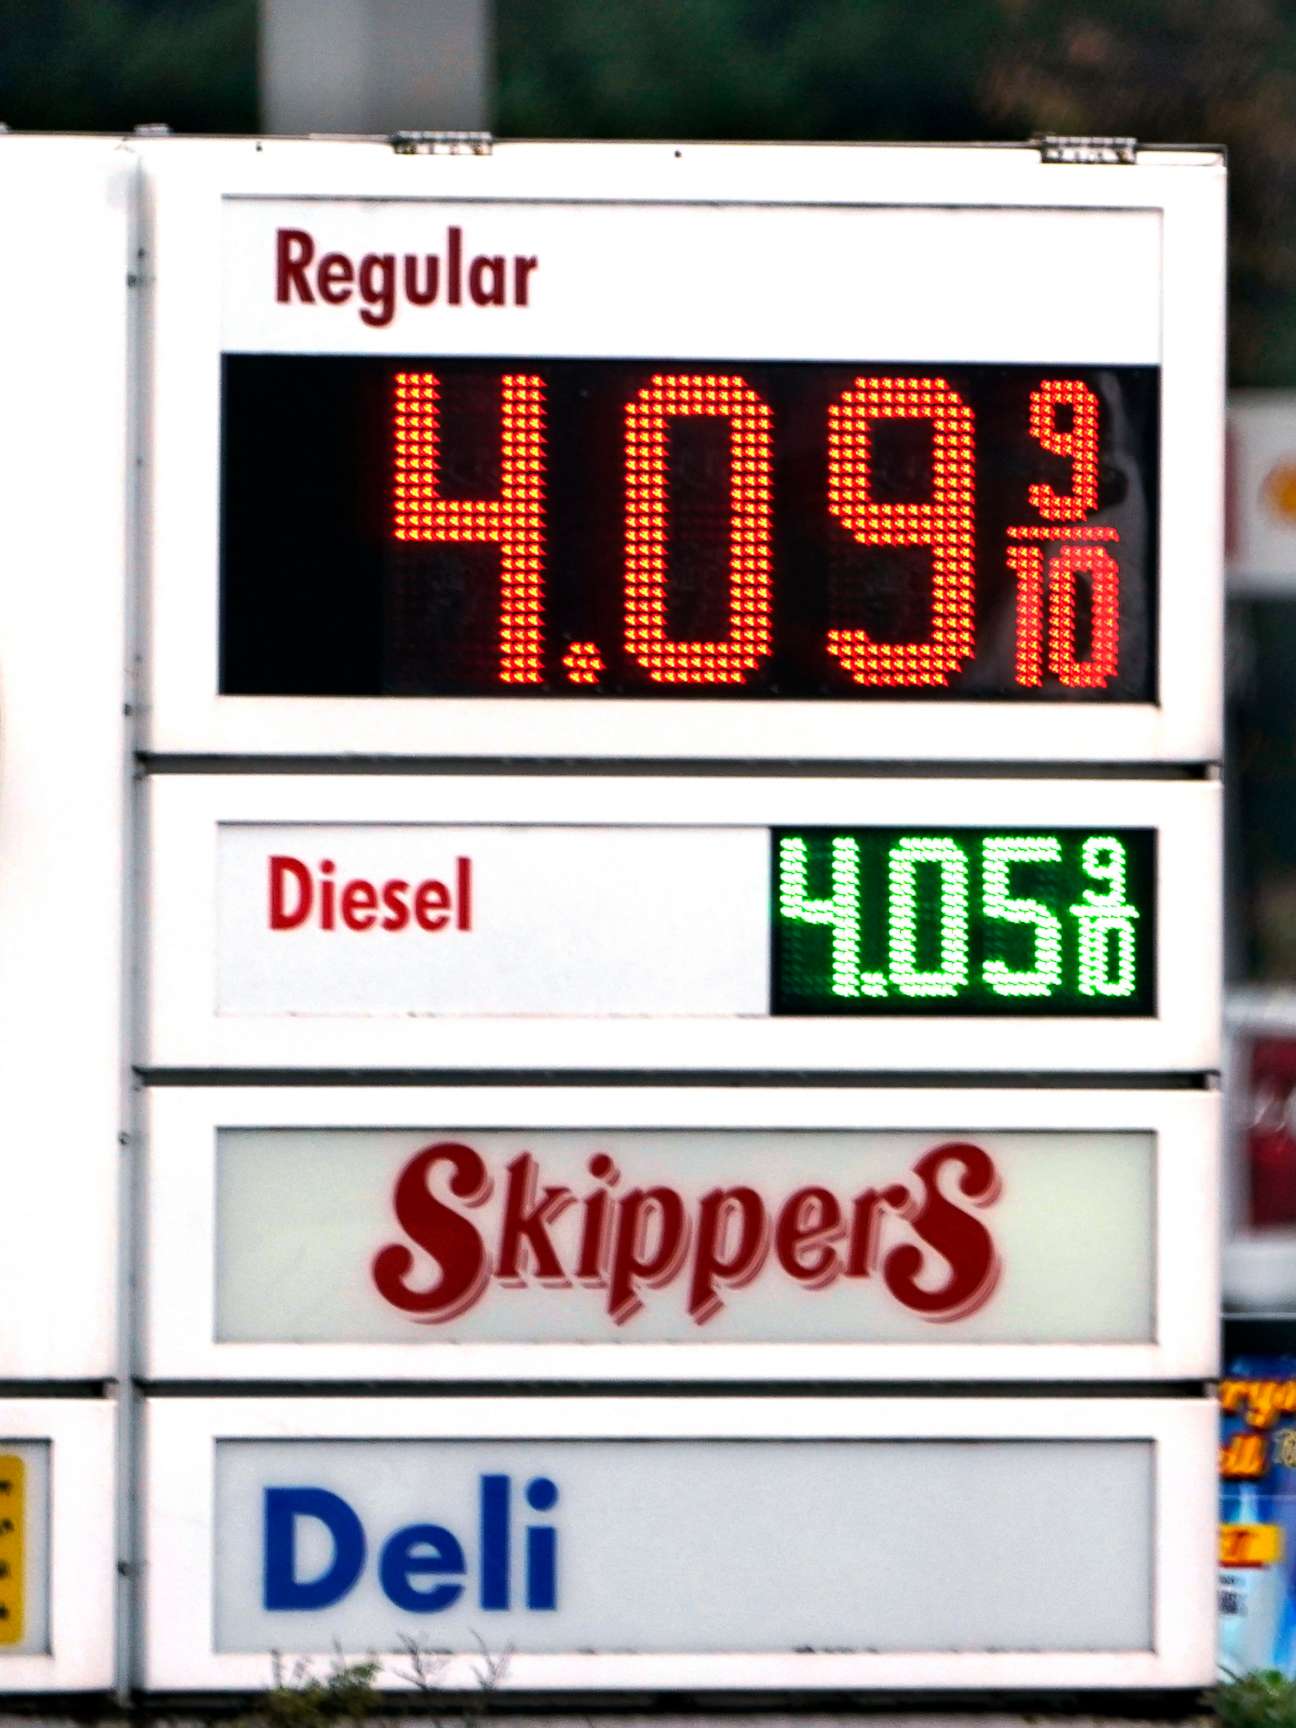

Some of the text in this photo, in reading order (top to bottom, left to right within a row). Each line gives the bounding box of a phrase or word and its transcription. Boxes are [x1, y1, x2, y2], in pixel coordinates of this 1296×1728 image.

[278, 227, 538, 327] Regular
[1028, 379, 1099, 522] 9
[392, 372, 976, 688] 4.09
[269, 855, 471, 931] Diesel
[778, 835, 1064, 998] 4.05
[263, 1473, 559, 1614] Deli
